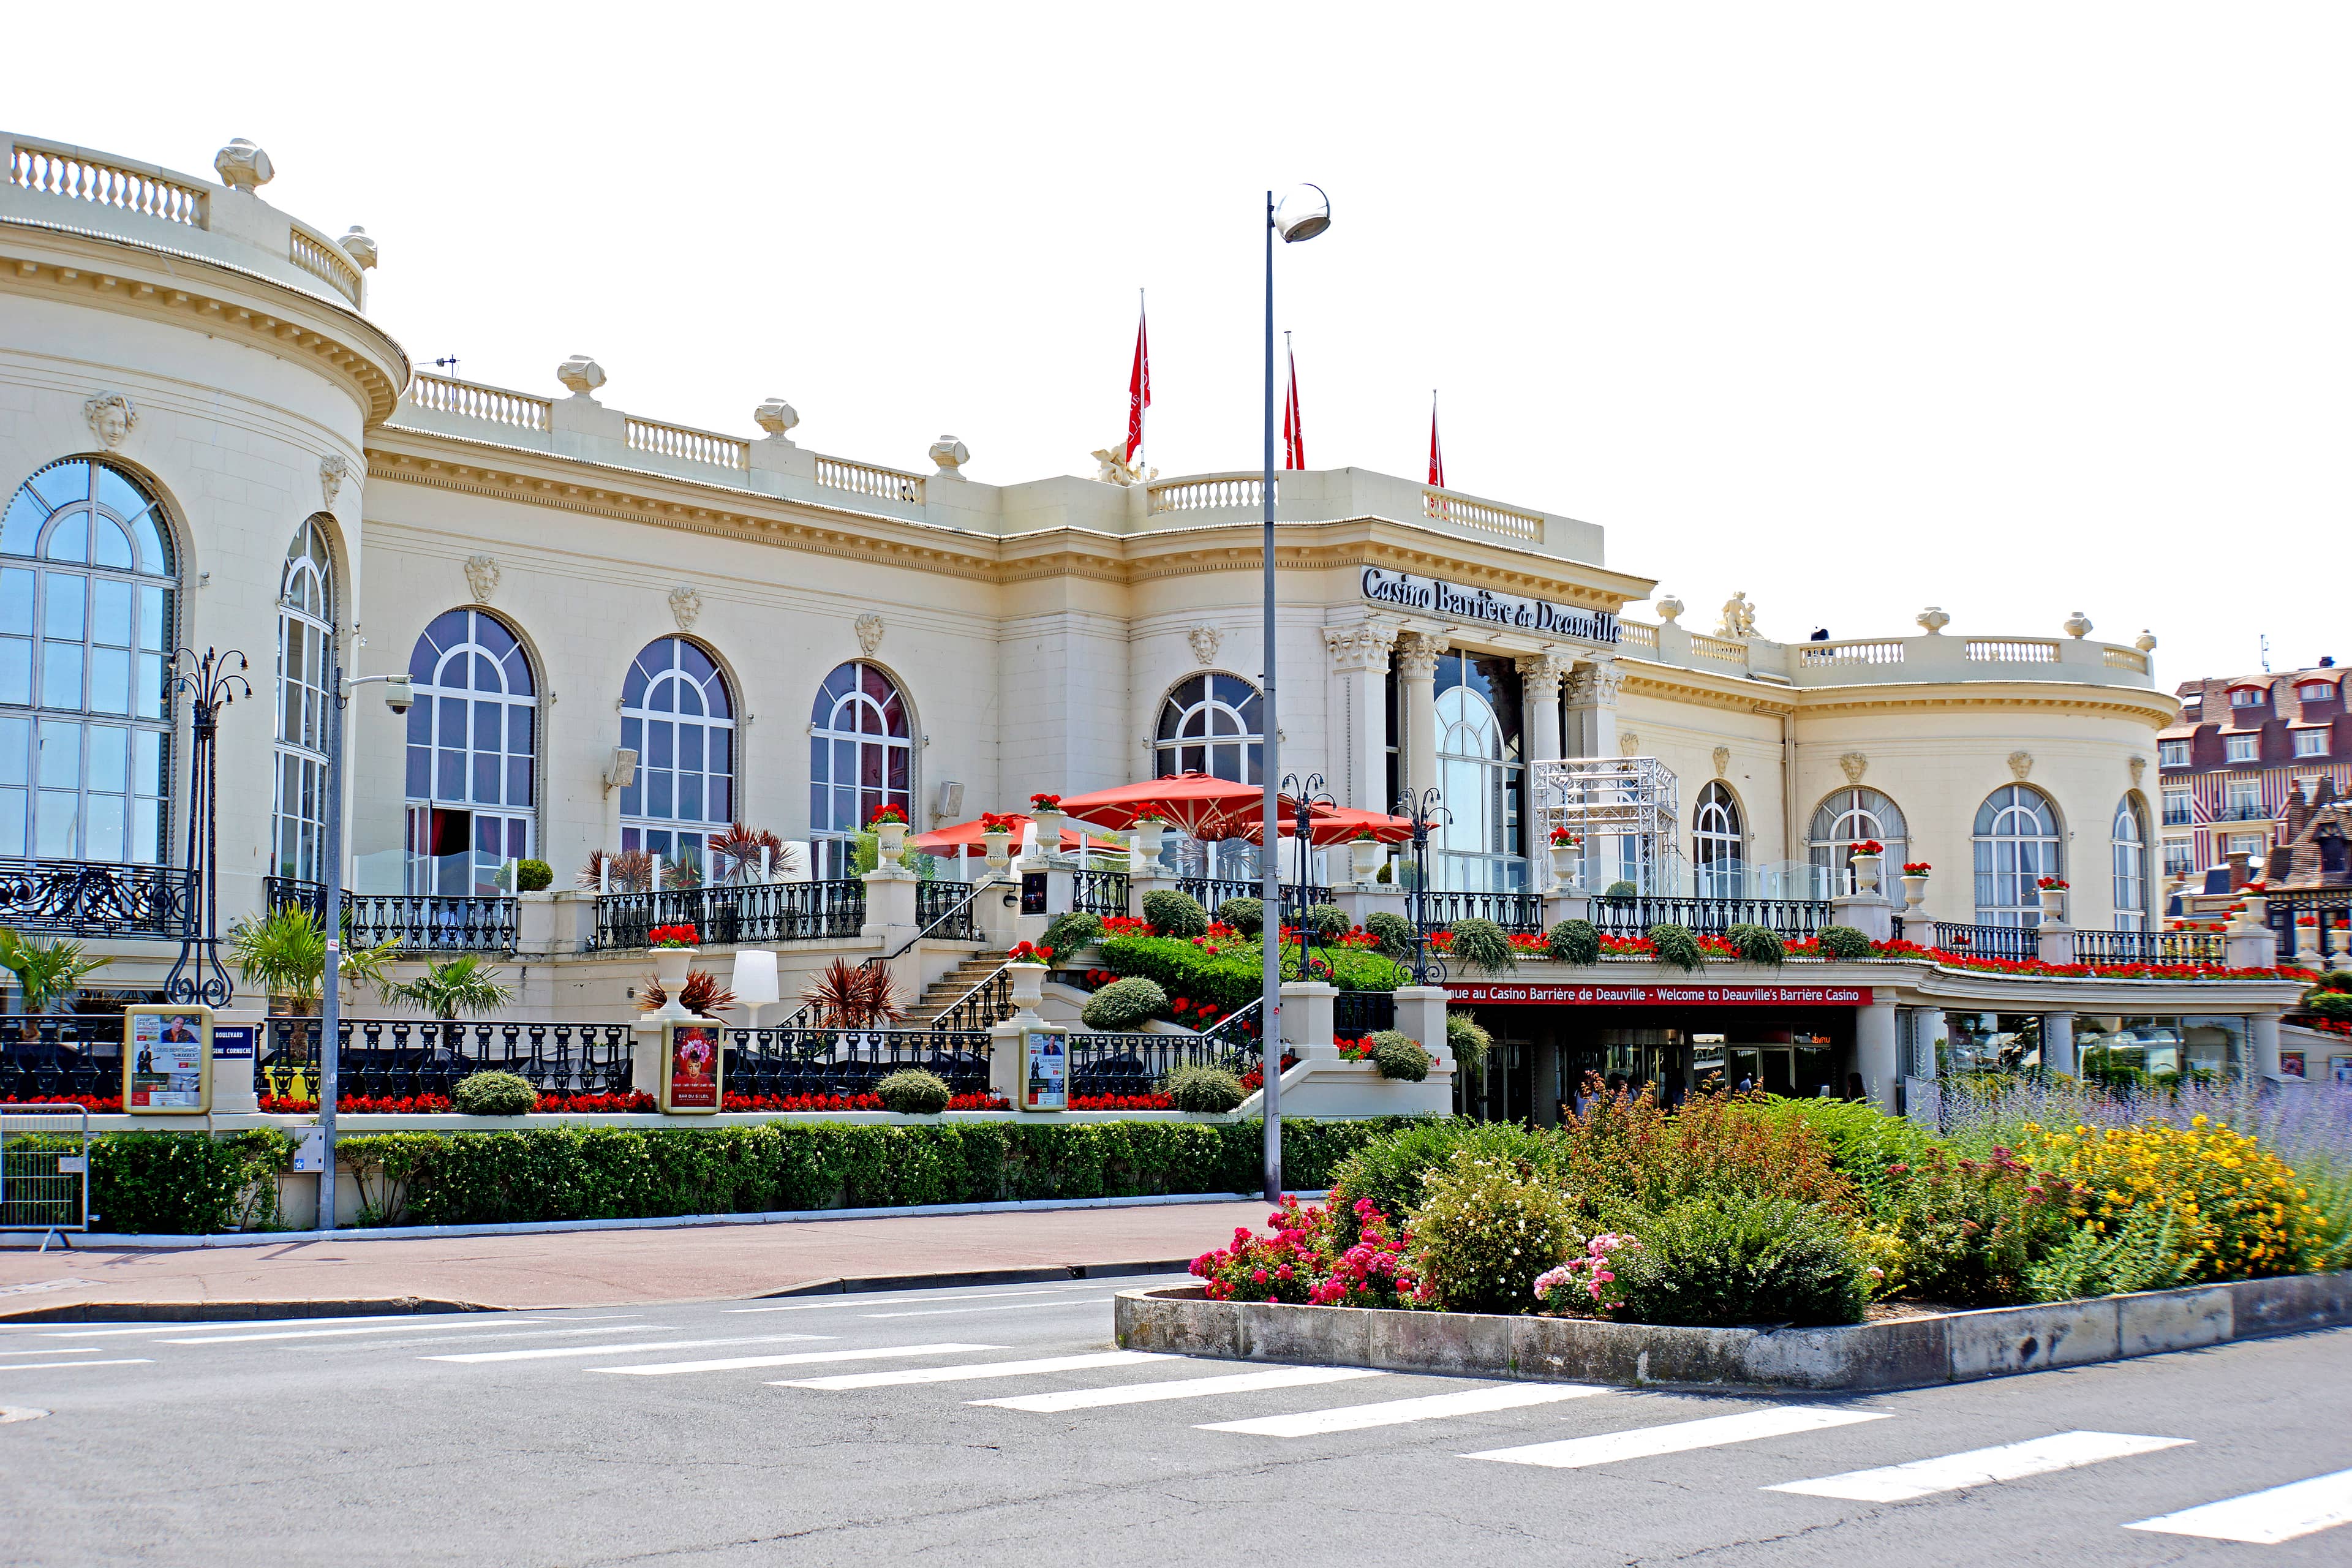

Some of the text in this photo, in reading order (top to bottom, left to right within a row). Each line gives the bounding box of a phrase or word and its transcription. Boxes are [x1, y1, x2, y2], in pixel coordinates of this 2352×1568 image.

[1363, 568, 1623, 643] Casino Barrière de Deauville
[1472, 989, 1487, 1000] au
[1490, 987, 1526, 1000] Casino
[1530, 987, 1575, 1000] Barrière
[1578, 988, 1593, 1000] de
[1596, 988, 1646, 1000] Deauville
[1656, 988, 1705, 1000] Welcome
[1708, 990, 1720, 1000] to
[1722, 988, 1777, 1001] Deauville's
[1780, 988, 1823, 1001] Barrière
[1825, 989, 1860, 1001] Casino
